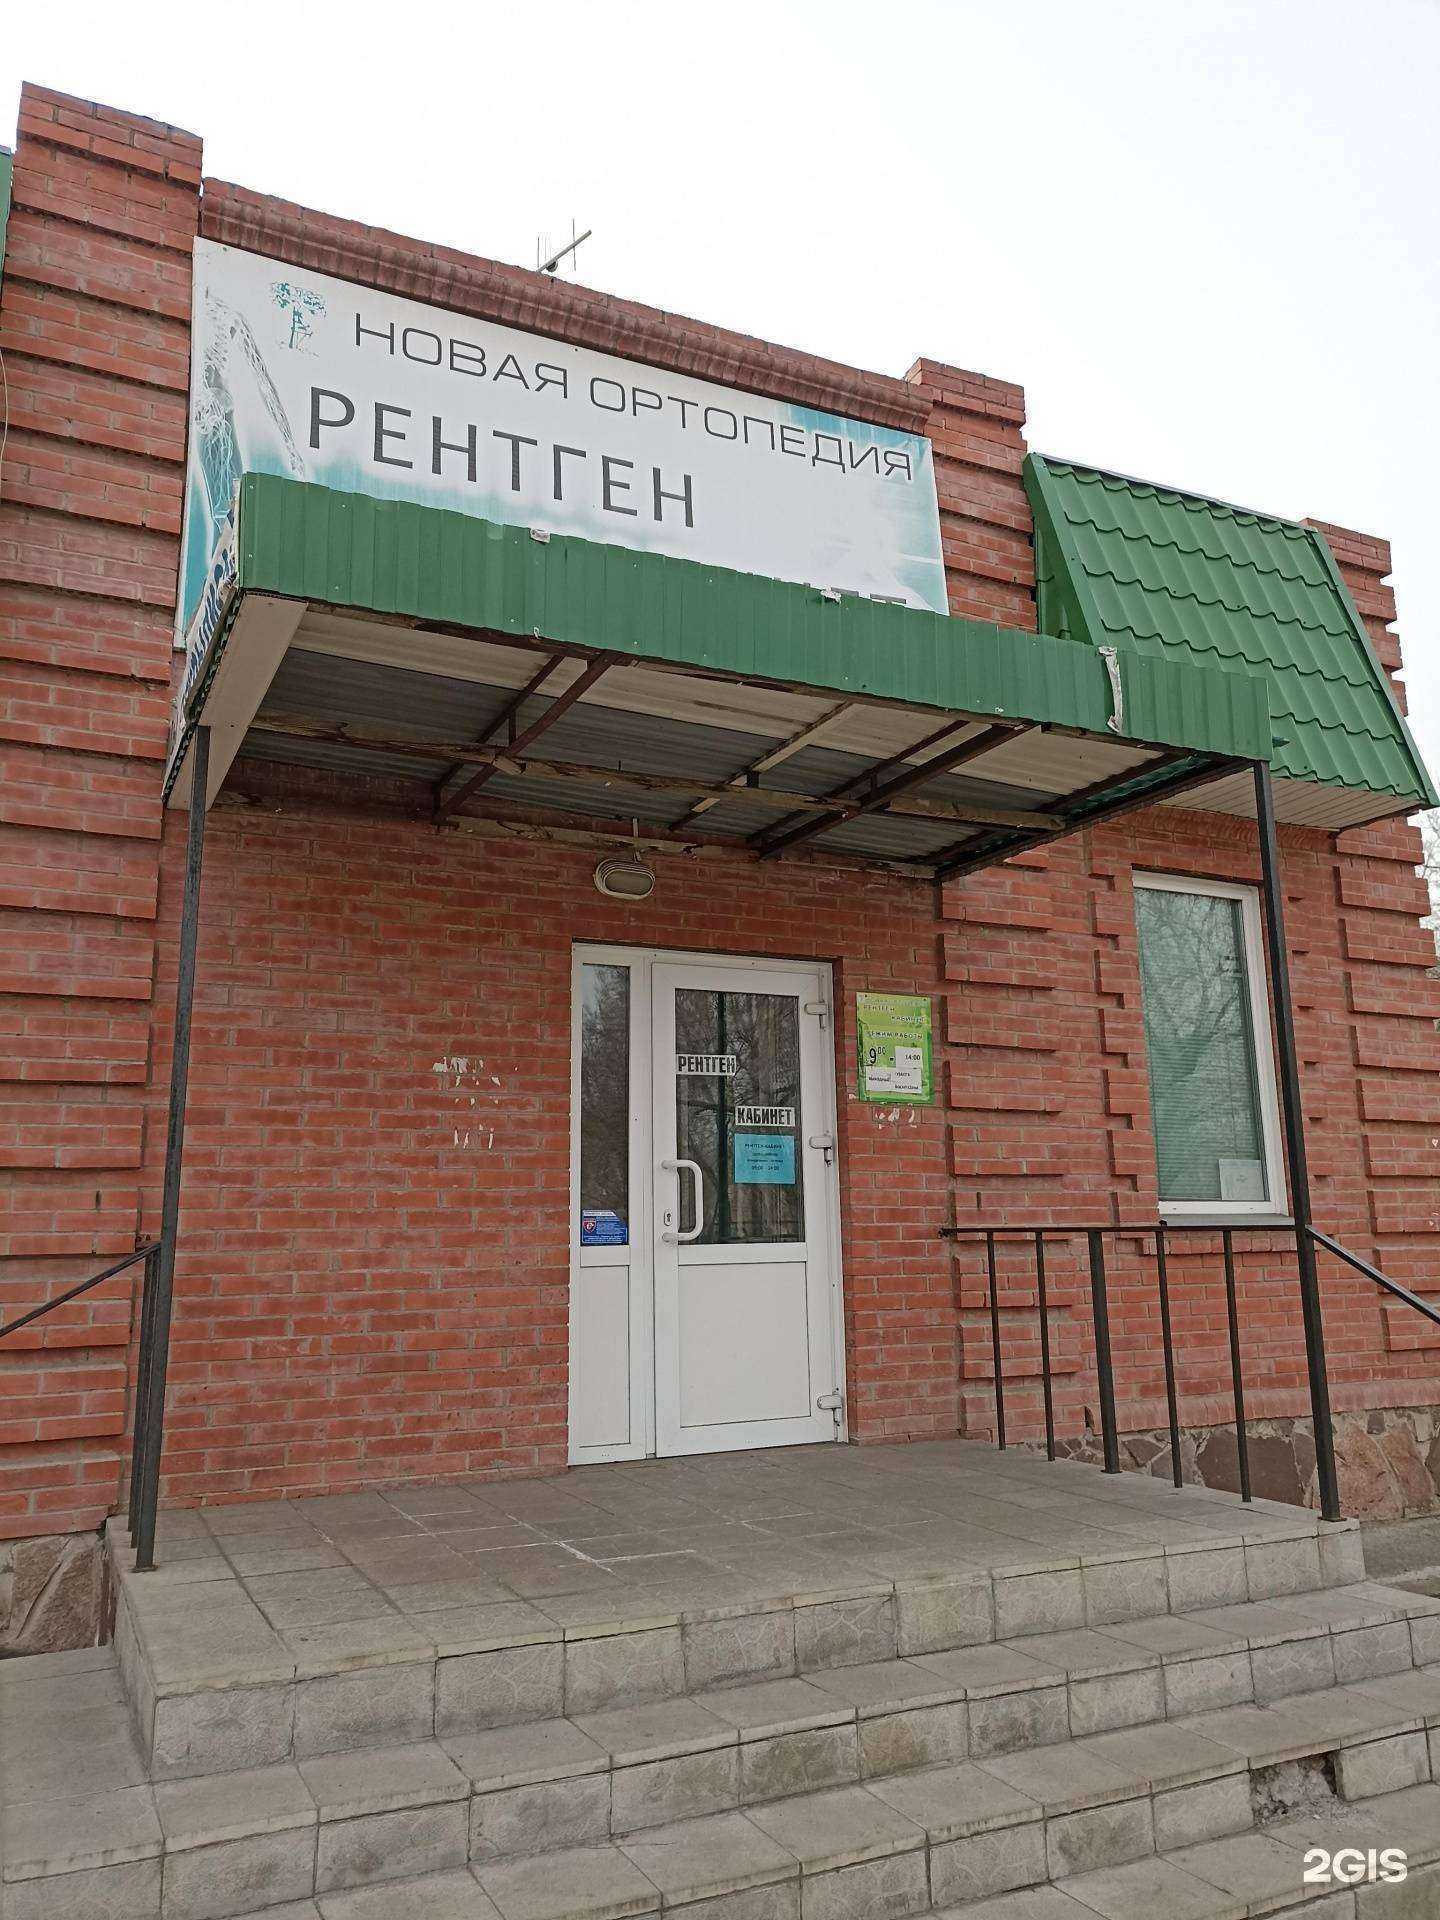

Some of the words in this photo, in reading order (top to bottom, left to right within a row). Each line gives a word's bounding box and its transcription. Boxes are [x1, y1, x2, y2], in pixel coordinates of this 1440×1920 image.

[355, 312, 568, 399] НОВАЯ
[591, 377, 913, 482] ОРТОПЕДИЯ
[309, 386, 694, 528] РЕНТГЕН
[678, 1055, 735, 1073] РЕНТГЕН
[737, 1107, 792, 1125] КАБИНЕТ
